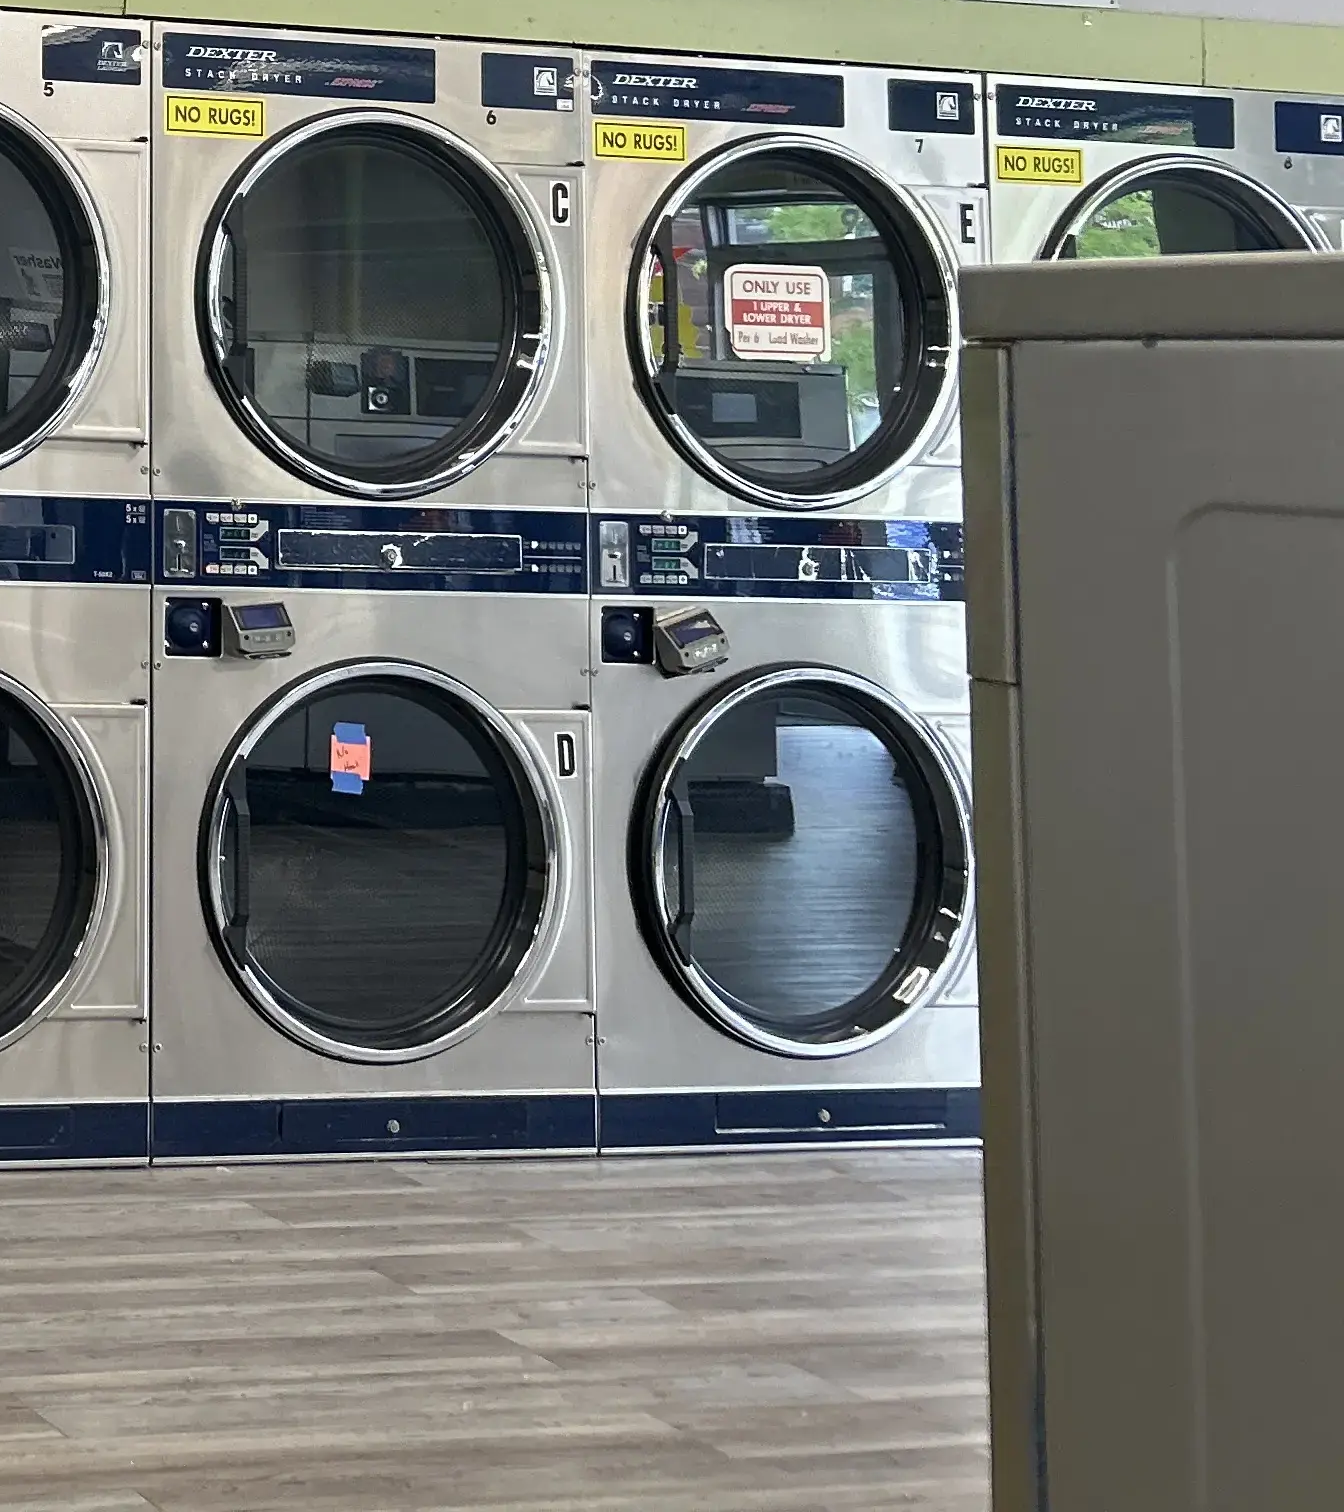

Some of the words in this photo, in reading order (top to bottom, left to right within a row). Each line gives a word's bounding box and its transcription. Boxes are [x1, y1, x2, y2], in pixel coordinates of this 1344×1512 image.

[185, 46, 278, 63] DEXTER
[251, 72, 303, 85] DRYER
[612, 73, 698, 89] DEXTER
[43, 81, 55, 98] 5
[612, 94, 661, 107] STACK
[673, 98, 722, 111] DRYER
[1015, 96, 1097, 111] DEXTER
[174, 105, 201, 124] NO
[207, 107, 257, 127] RUGS!
[485, 109, 497, 126] 6
[1015, 117, 1061, 129] STACK
[602, 131, 627, 149] NO
[633, 133, 678, 152] RUGS!
[914, 138, 924, 154] 7
[1004, 156, 1027, 172] NO
[1032, 157, 1075, 174] RUGS!
[552, 182, 569, 224] C
[959, 202, 976, 245] E
[742, 279, 779, 294] ONLY
[785, 281, 811, 295] USE
[760, 301, 790, 312] UPPER
[793, 302, 801, 312] &
[742, 312, 777, 323] LOWER
[780, 314, 811, 324] DRYER
[768, 331, 787, 344] Load
[789, 332, 819, 345] Washer
[556, 732, 576, 778] D
